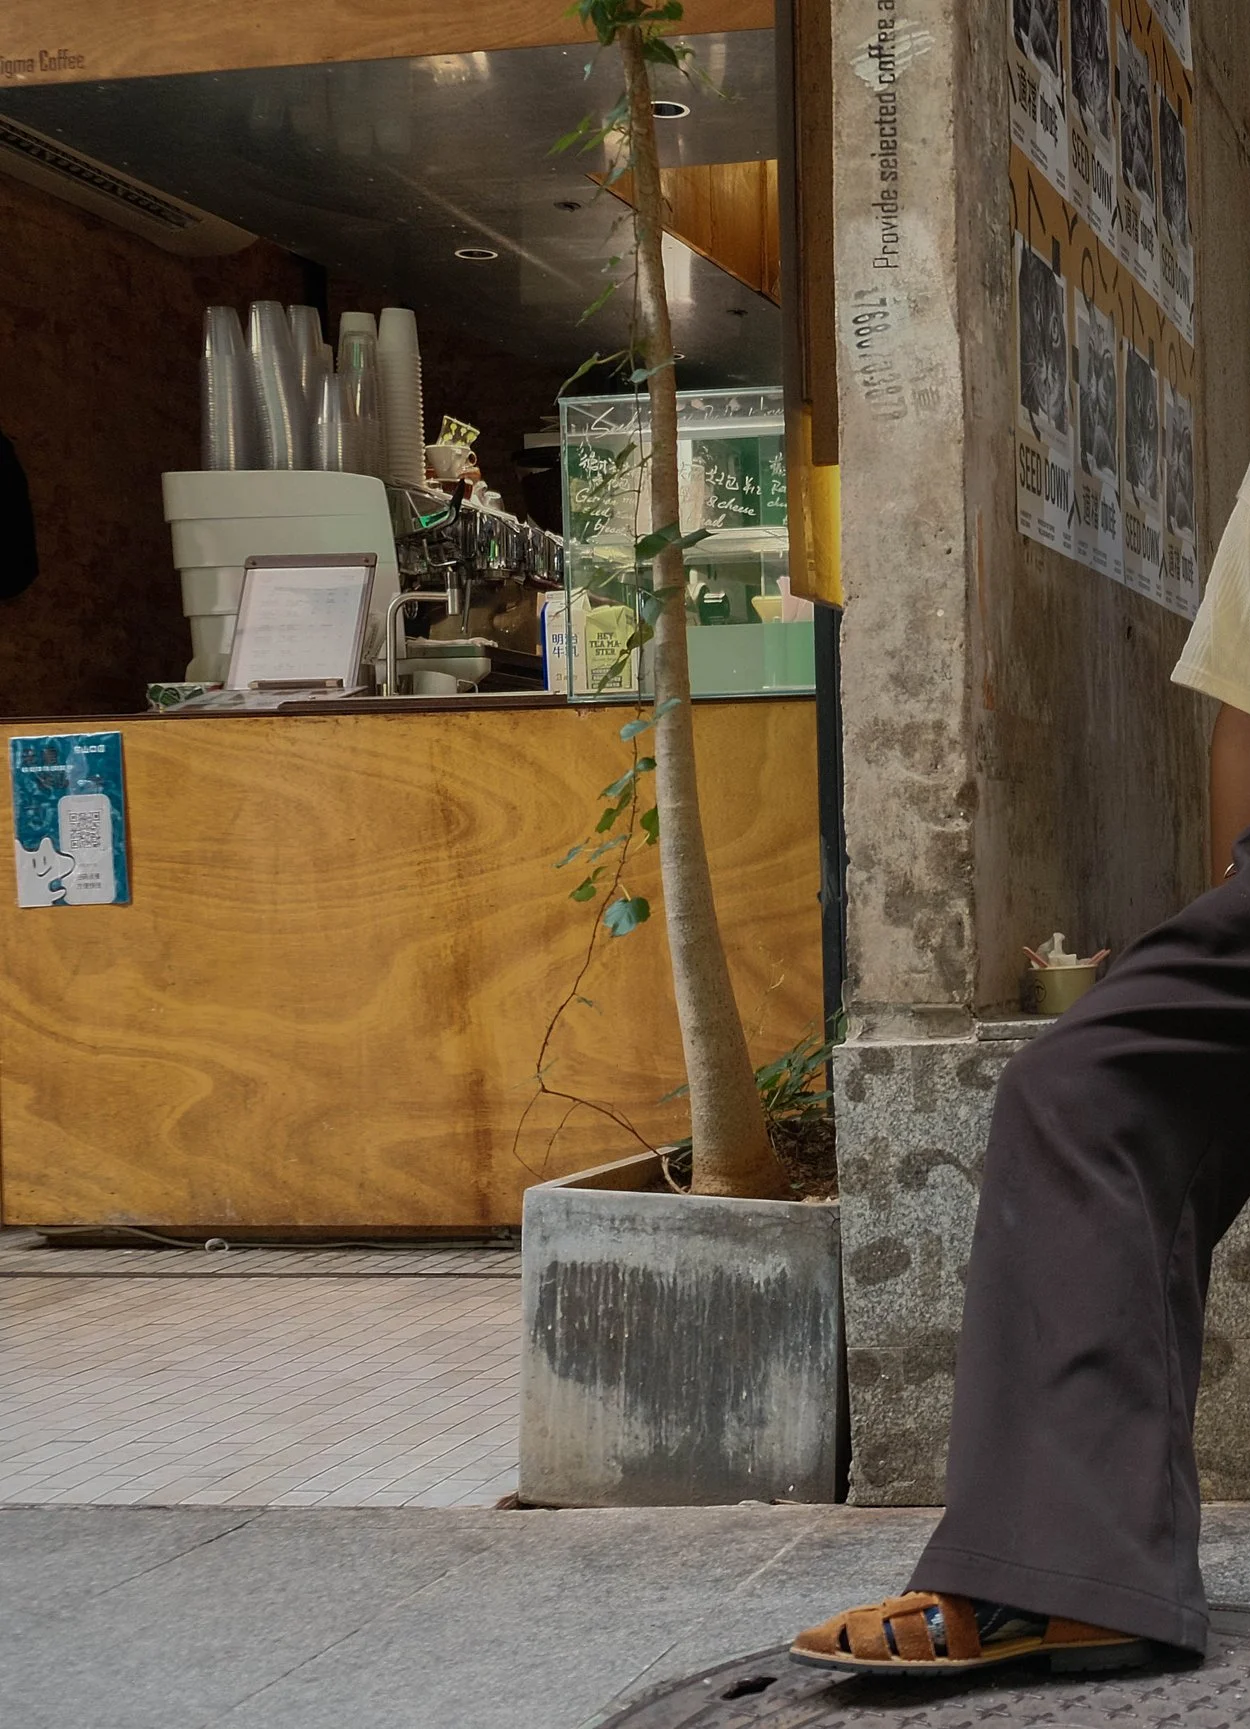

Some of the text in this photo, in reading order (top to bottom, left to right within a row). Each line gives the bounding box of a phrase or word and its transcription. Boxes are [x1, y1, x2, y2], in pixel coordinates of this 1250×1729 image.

[39, 48, 85, 72] Coffee
[868, 18, 896, 85] coffee
[1071, 128, 1090, 185] SEED
[1091, 152, 1113, 215] DOWN
[872, 190, 900, 269] Provide
[1160, 242, 1175, 289] SEED
[717, 497, 756, 516] cheese
[1019, 442, 1069, 514] SEED DOWN
[1125, 511, 1141, 556] SEED
[1142, 522, 1161, 568] DOWN
[597, 632, 614, 640] HEY
